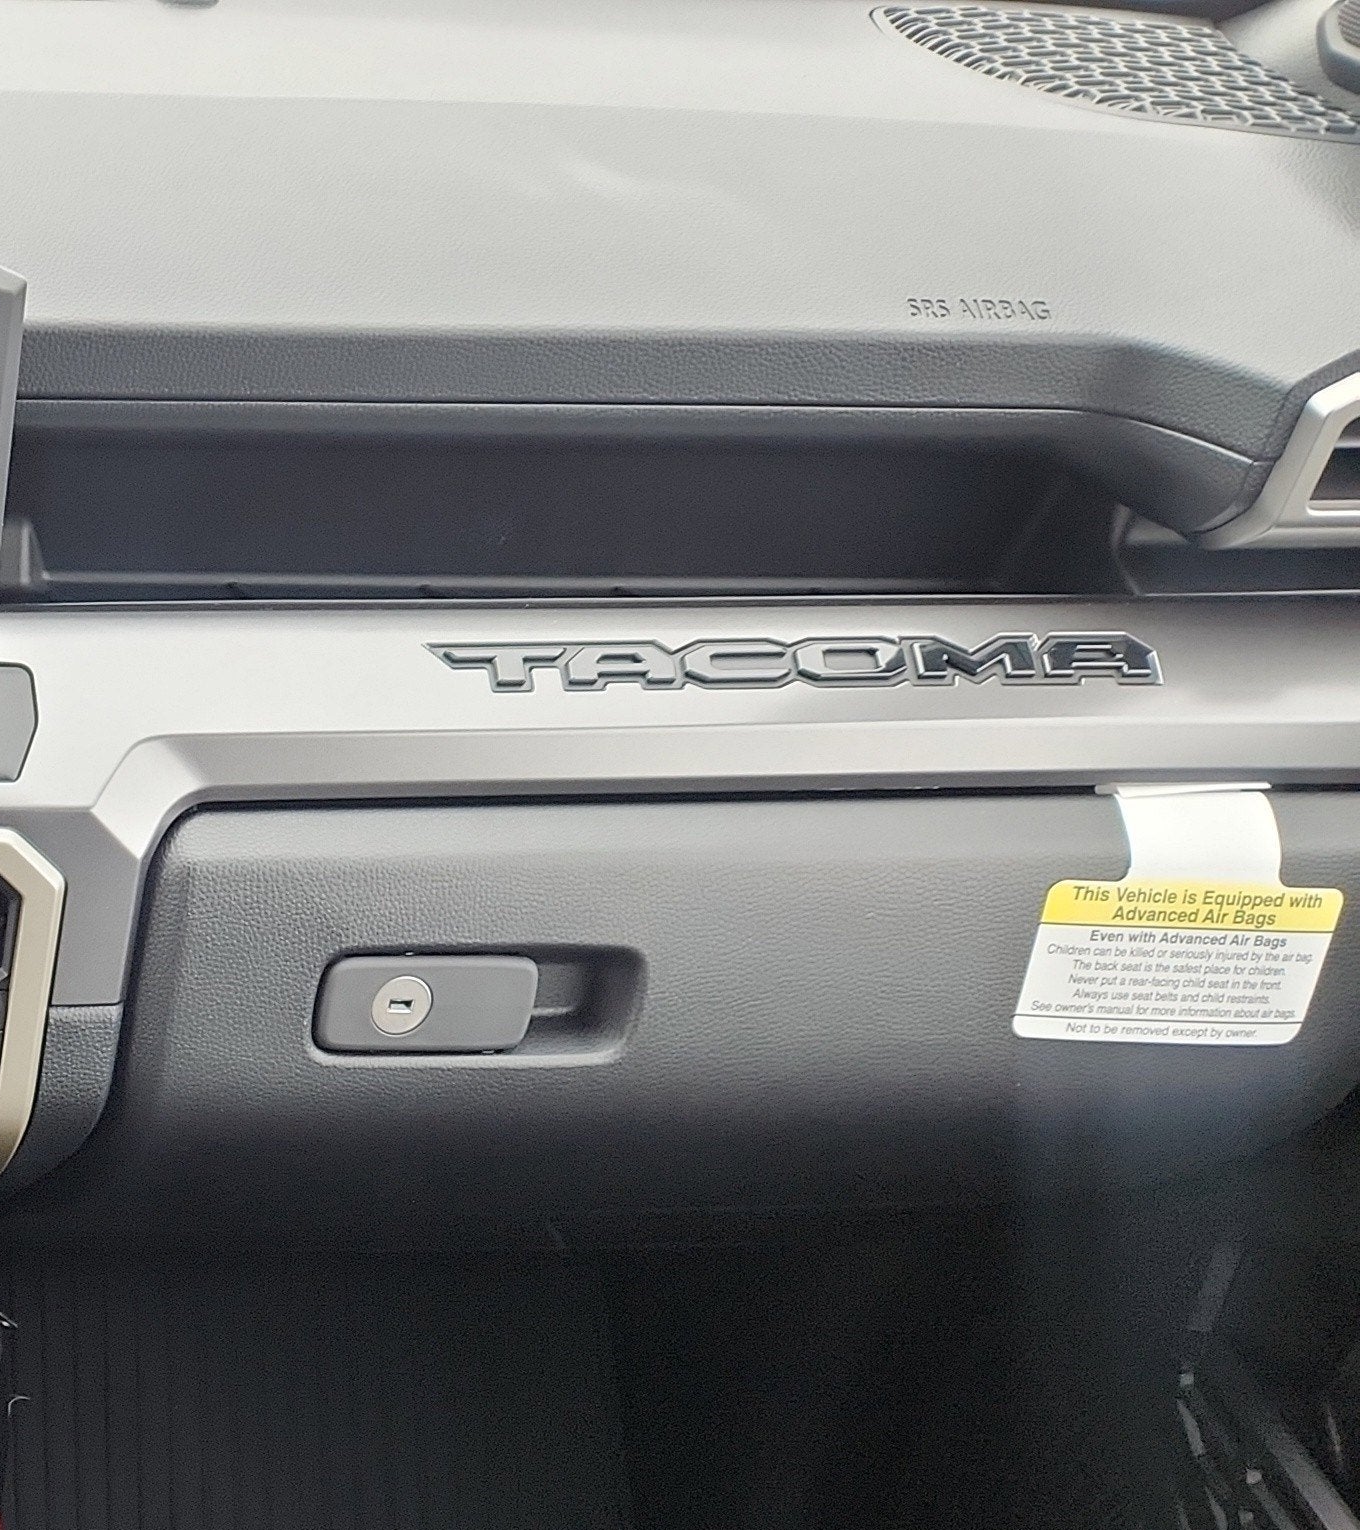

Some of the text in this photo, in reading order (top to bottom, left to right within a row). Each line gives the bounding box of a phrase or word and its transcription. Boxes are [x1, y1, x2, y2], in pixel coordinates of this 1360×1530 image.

[906, 298, 1052, 320] SRS AIRBAG
[422, 630, 1165, 693] TACOMA
[1072, 885, 1323, 911] This Vehicle is Equipped with
[1111, 905, 1277, 929] Advanced Air Bags
[1089, 929, 1288, 950] Even with Advanced Air Bags
[1072, 958, 1092, 970] The
[1094, 960, 1118, 971] back
[1120, 961, 1142, 971] seat
[1144, 961, 1153, 971] is
[1154, 962, 1171, 972] the
[1172, 963, 1203, 974] safest
[1203, 964, 1231, 976] place
[1233, 965, 1246, 976] for
[1065, 1022, 1258, 1040] Not to be removed except by owner.
